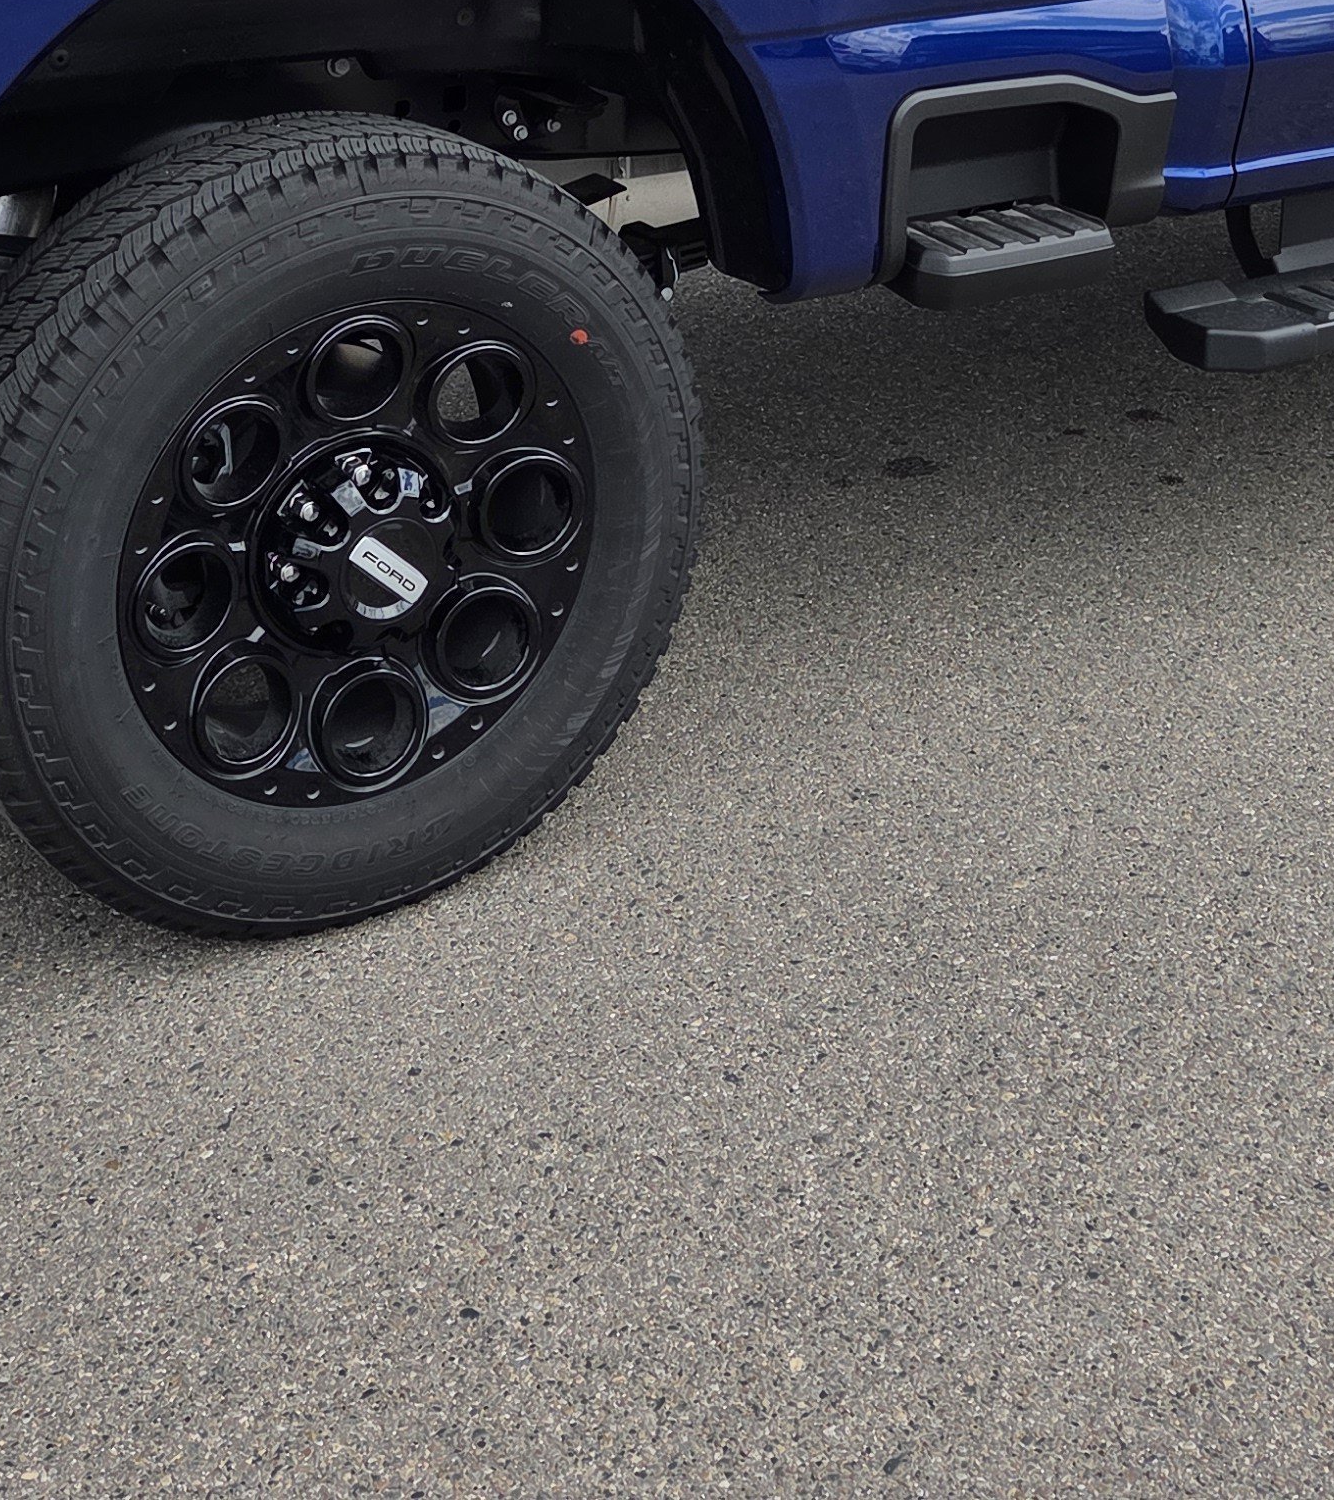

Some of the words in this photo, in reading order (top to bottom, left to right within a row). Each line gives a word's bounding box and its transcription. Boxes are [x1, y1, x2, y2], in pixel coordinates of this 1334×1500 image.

[348, 244, 591, 329] DUELER
[362, 550, 415, 592] FORD
[119, 783, 461, 877] BRIDGESTONE
